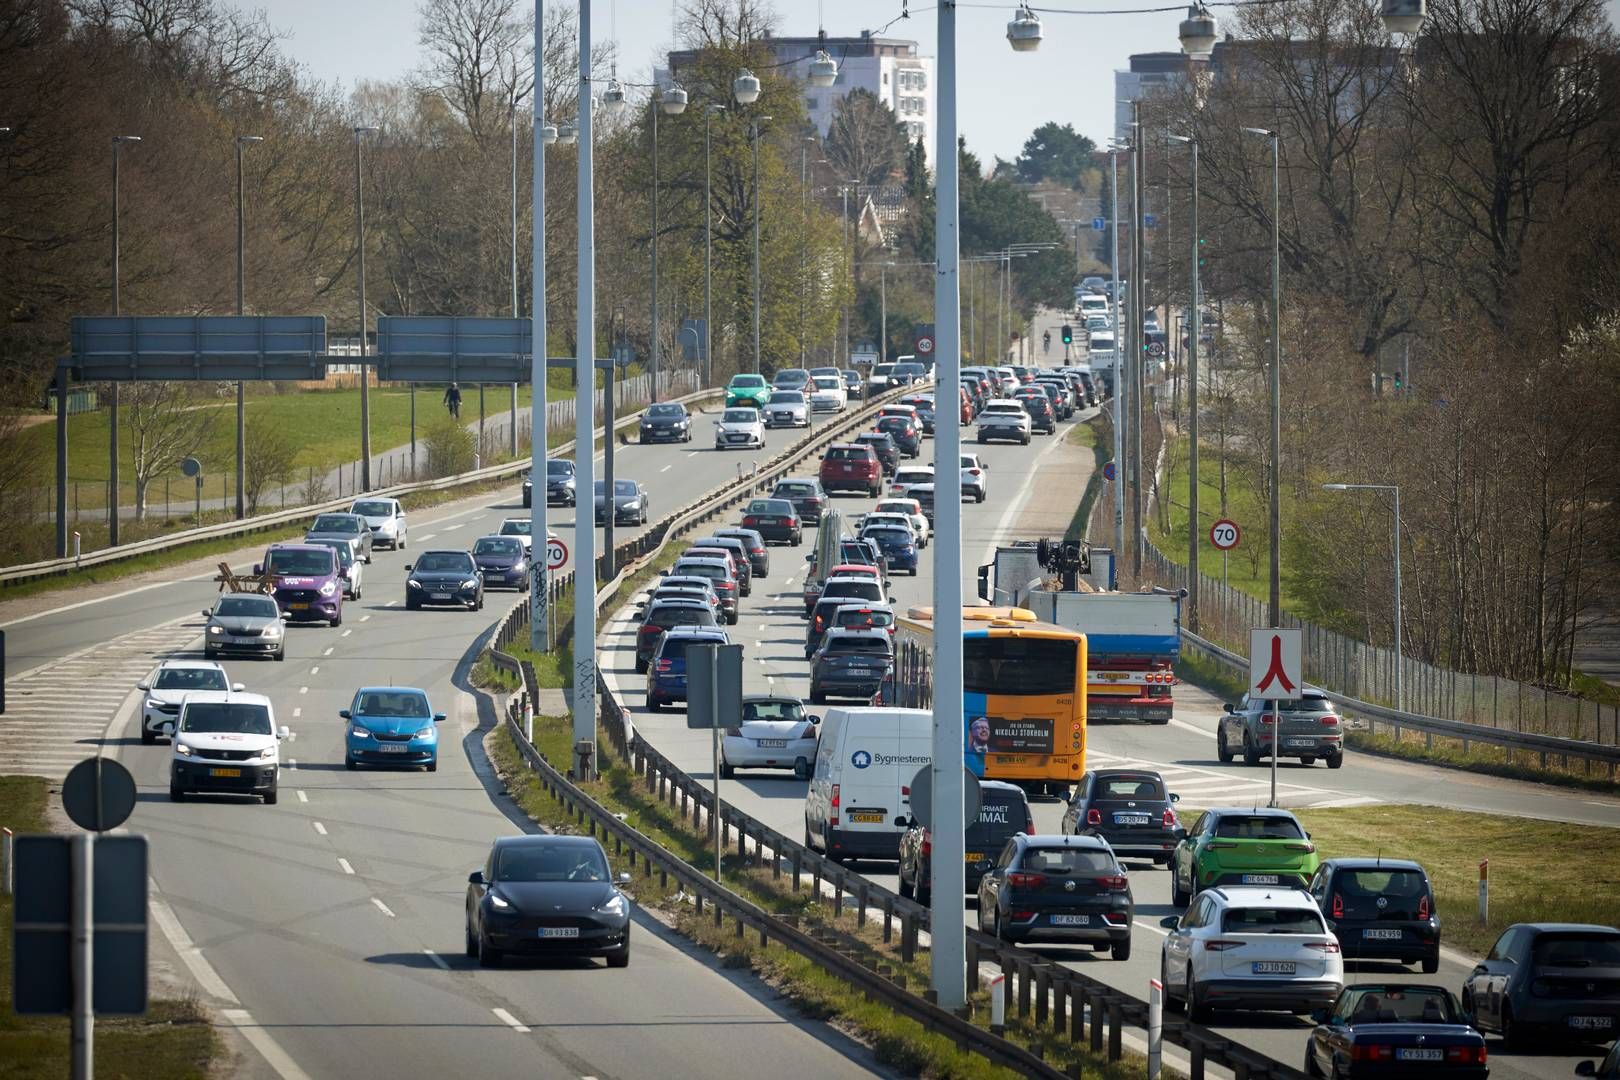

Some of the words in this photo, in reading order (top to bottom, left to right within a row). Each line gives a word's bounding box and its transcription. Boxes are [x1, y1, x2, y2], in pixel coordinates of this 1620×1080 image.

[919, 341, 931, 349] 60
[1149, 344, 1161, 353] 60
[1216, 528, 1235, 541] 70
[994, 728, 1017, 737] NIKOLAJ
[1019, 728, 1048, 737] STOKHOLM
[874, 753, 932, 766] Bygmesteren
[981, 805, 1008, 813] IRMAET
[979, 813, 1008, 824] IMAL
